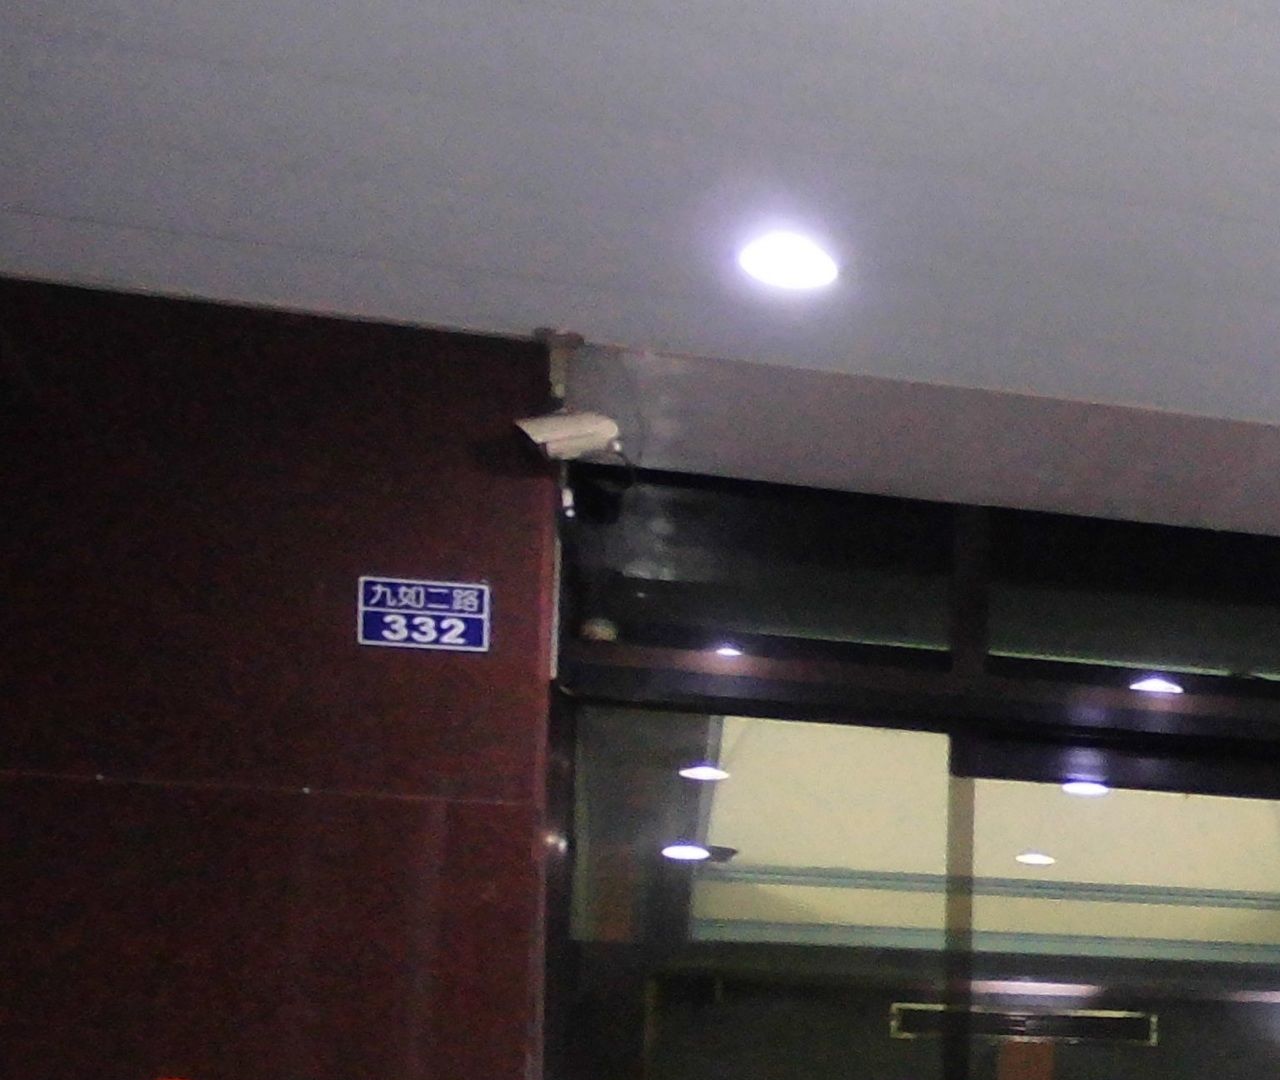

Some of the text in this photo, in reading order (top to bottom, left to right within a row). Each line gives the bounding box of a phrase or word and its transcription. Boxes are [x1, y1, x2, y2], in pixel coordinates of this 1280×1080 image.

[370, 584, 479, 611] 九如二路
[382, 614, 466, 644] 332
